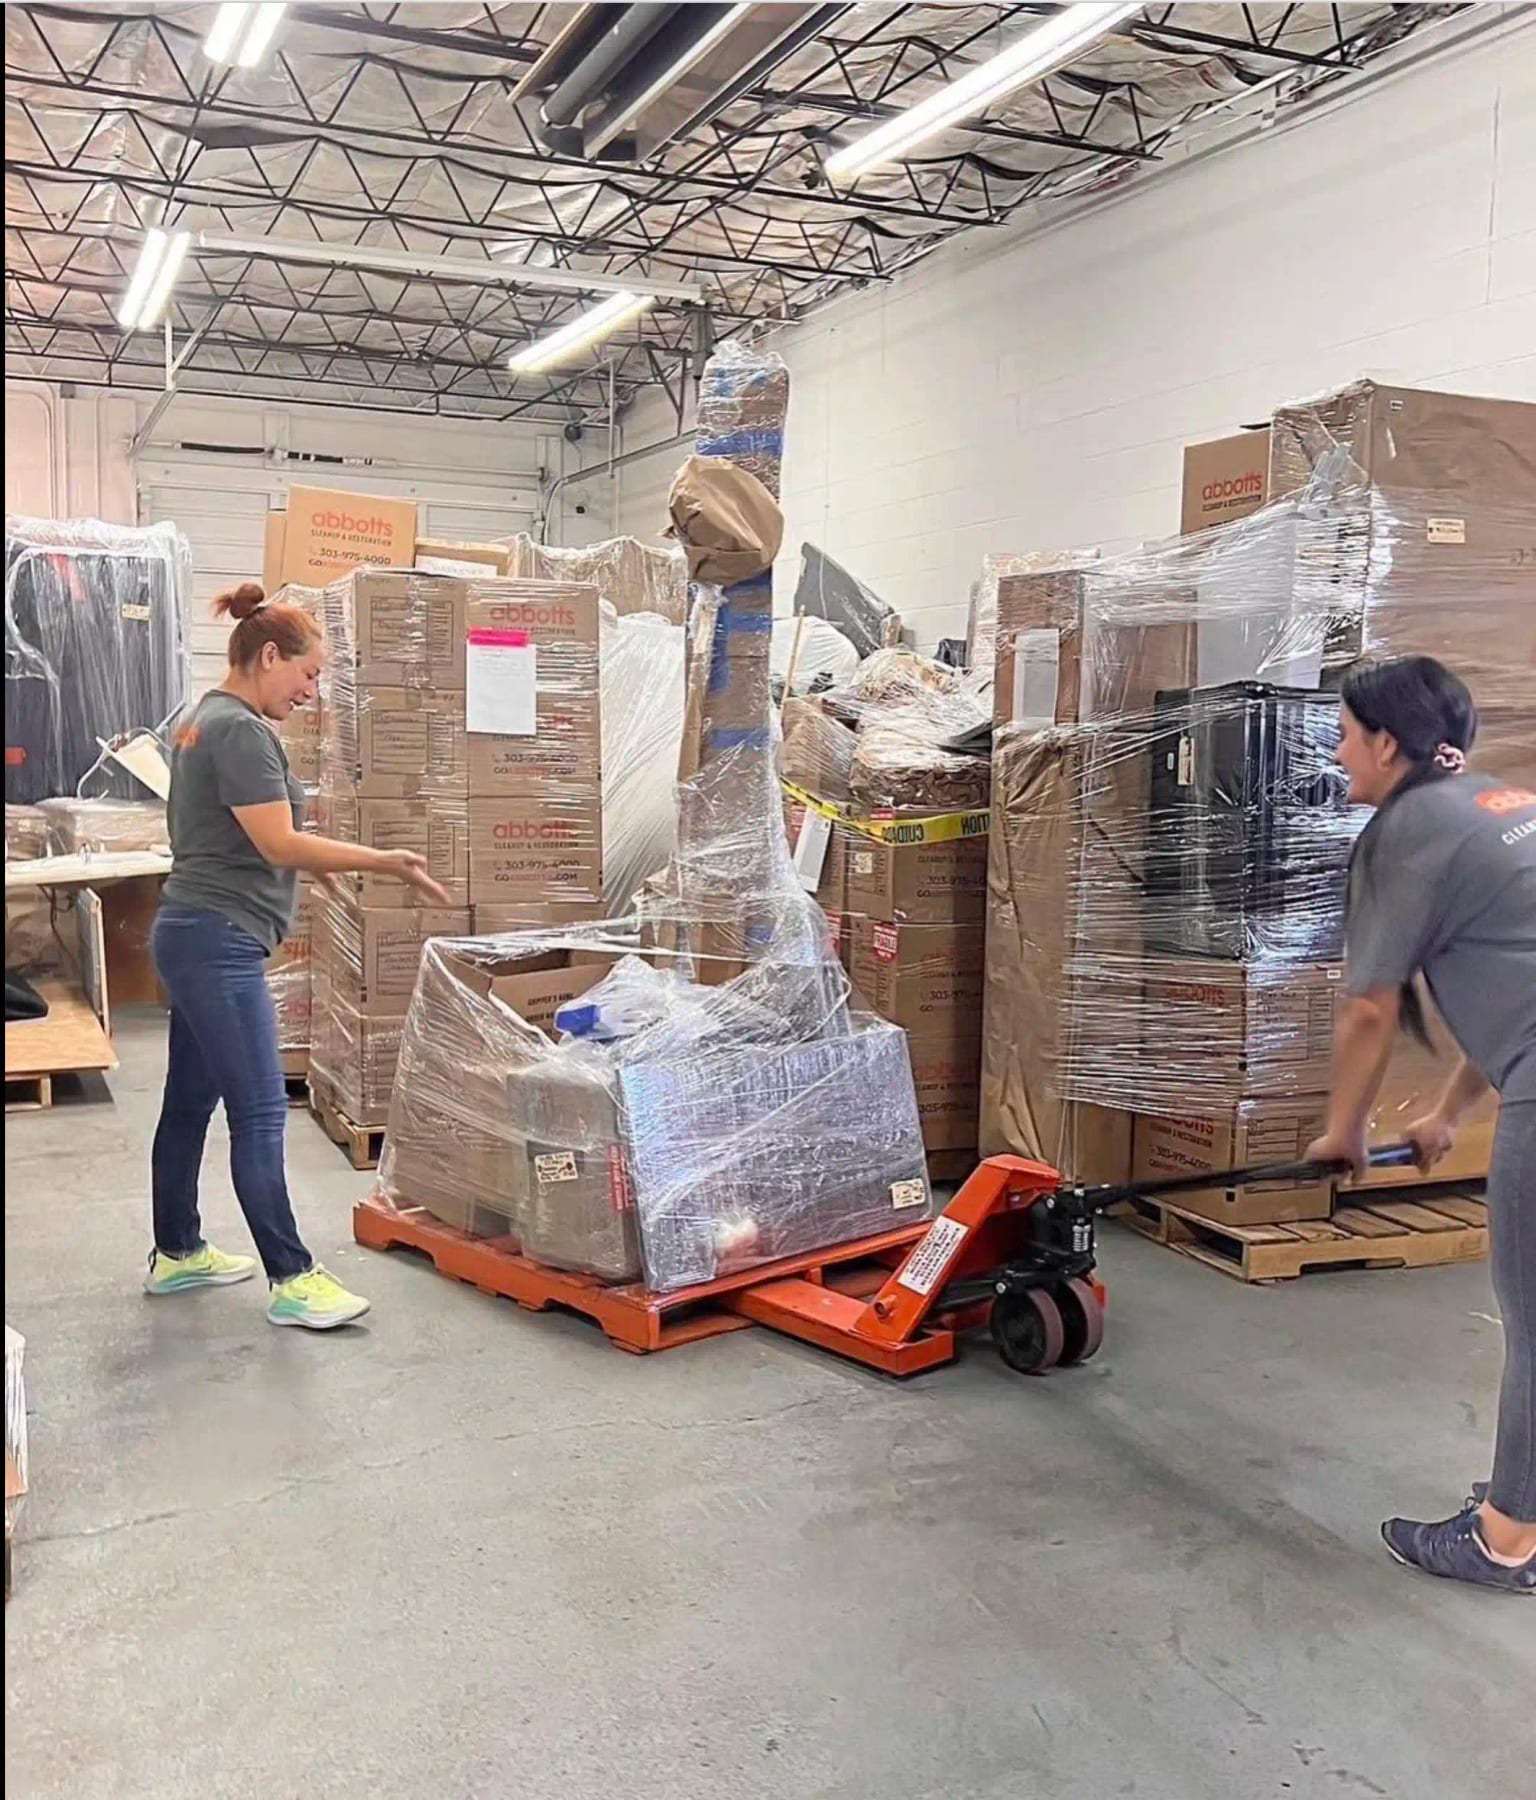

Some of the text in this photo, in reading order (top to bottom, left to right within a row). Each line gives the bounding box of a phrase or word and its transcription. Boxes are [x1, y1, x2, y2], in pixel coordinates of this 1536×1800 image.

[1202, 473, 1263, 500] abbotts
[311, 511, 393, 537] abbotts
[489, 603, 576, 625] abbotts
